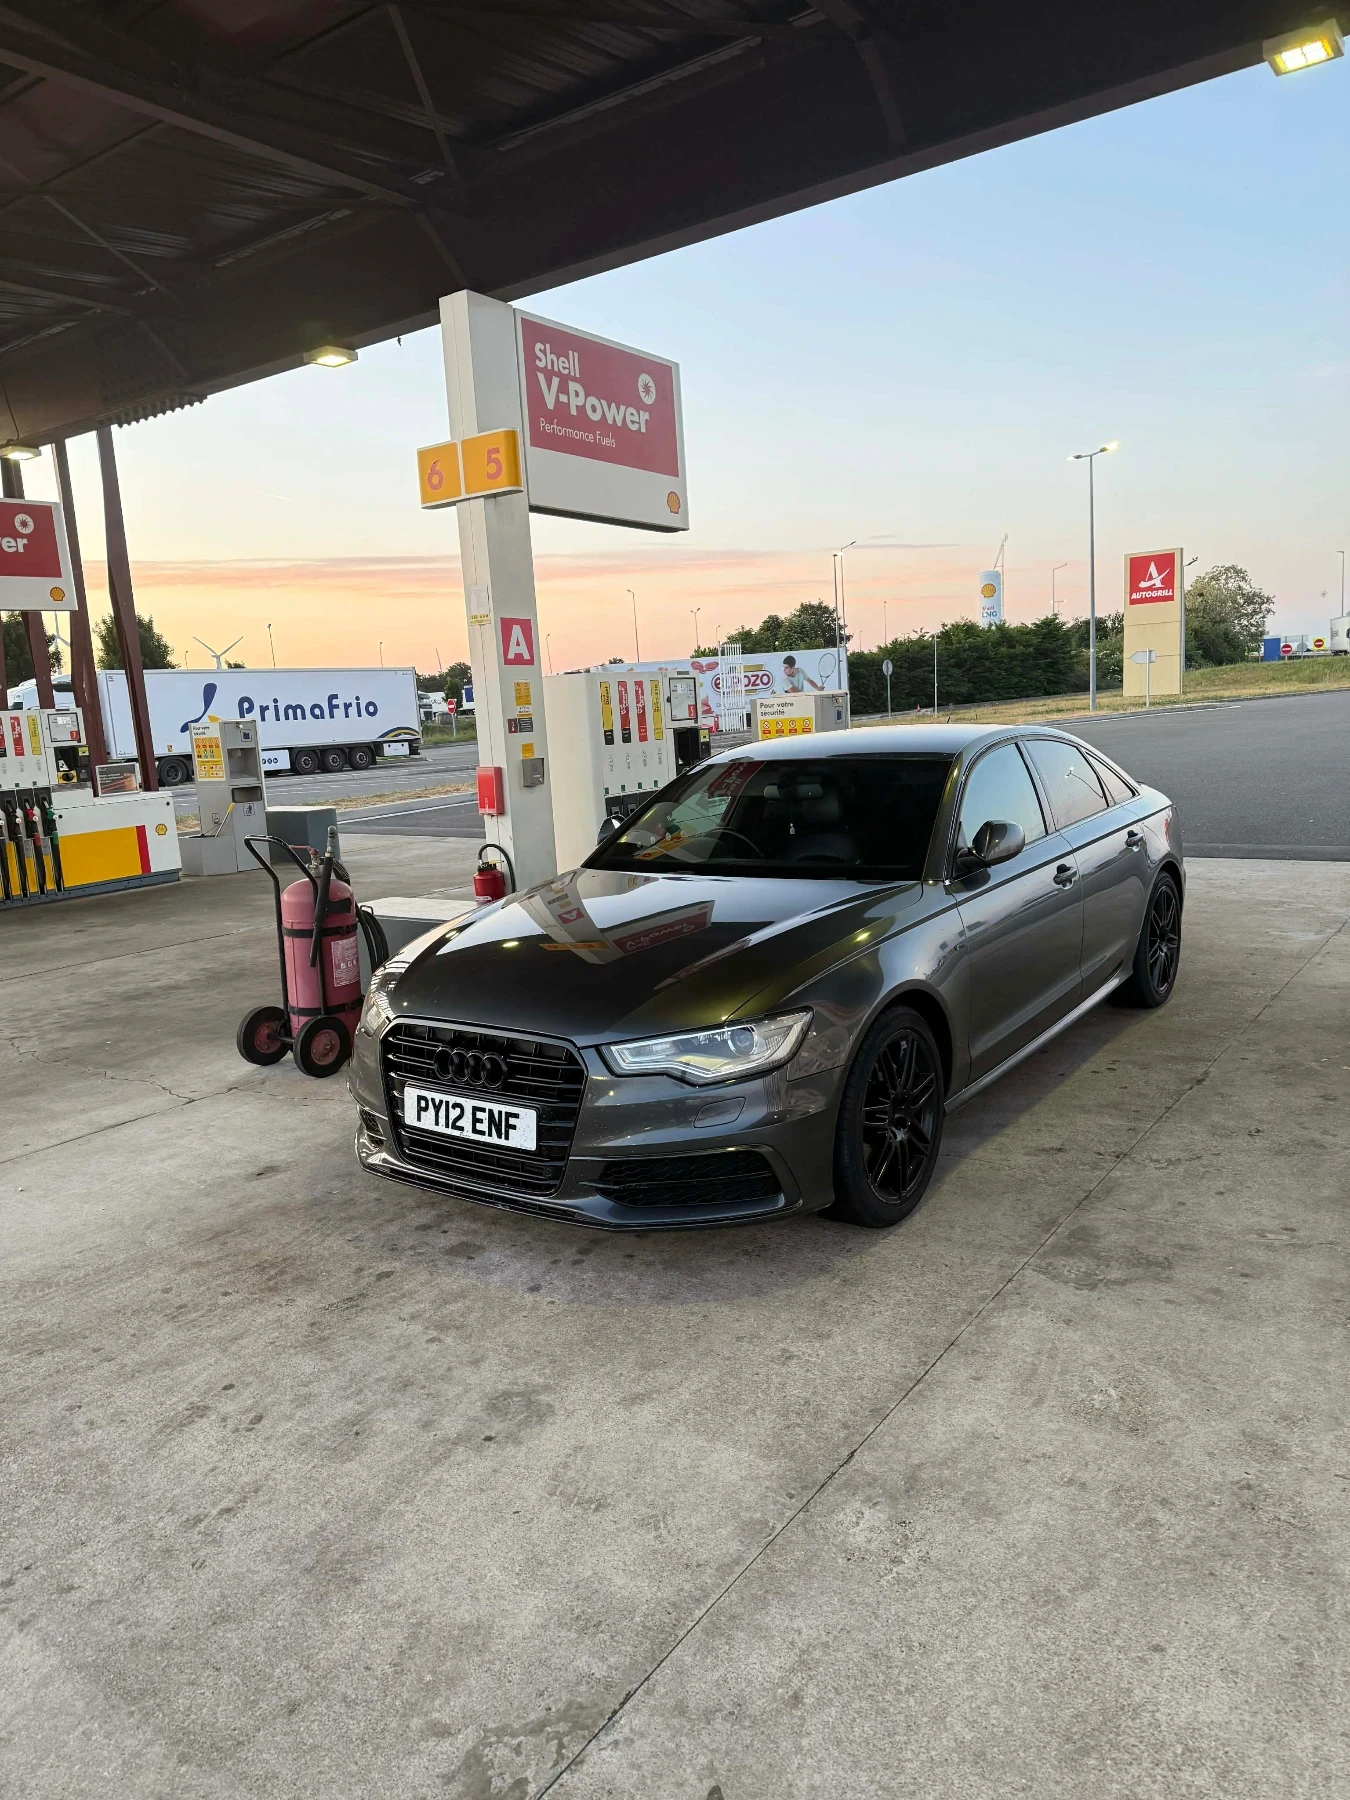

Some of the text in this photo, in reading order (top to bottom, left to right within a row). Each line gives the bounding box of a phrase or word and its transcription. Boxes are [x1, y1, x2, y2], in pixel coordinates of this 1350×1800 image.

[534, 342, 580, 378] Shell
[536, 371, 650, 433] V-Power
[540, 417, 616, 448] Performance Fuels
[427, 458, 444, 491] 6
[486, 447, 503, 480] 5
[0, 536, 28, 553] er
[1130, 588, 1174, 600] AUTOGRILL
[507, 625, 531, 659] A
[416, 1094, 520, 1141] PY12 ENF
